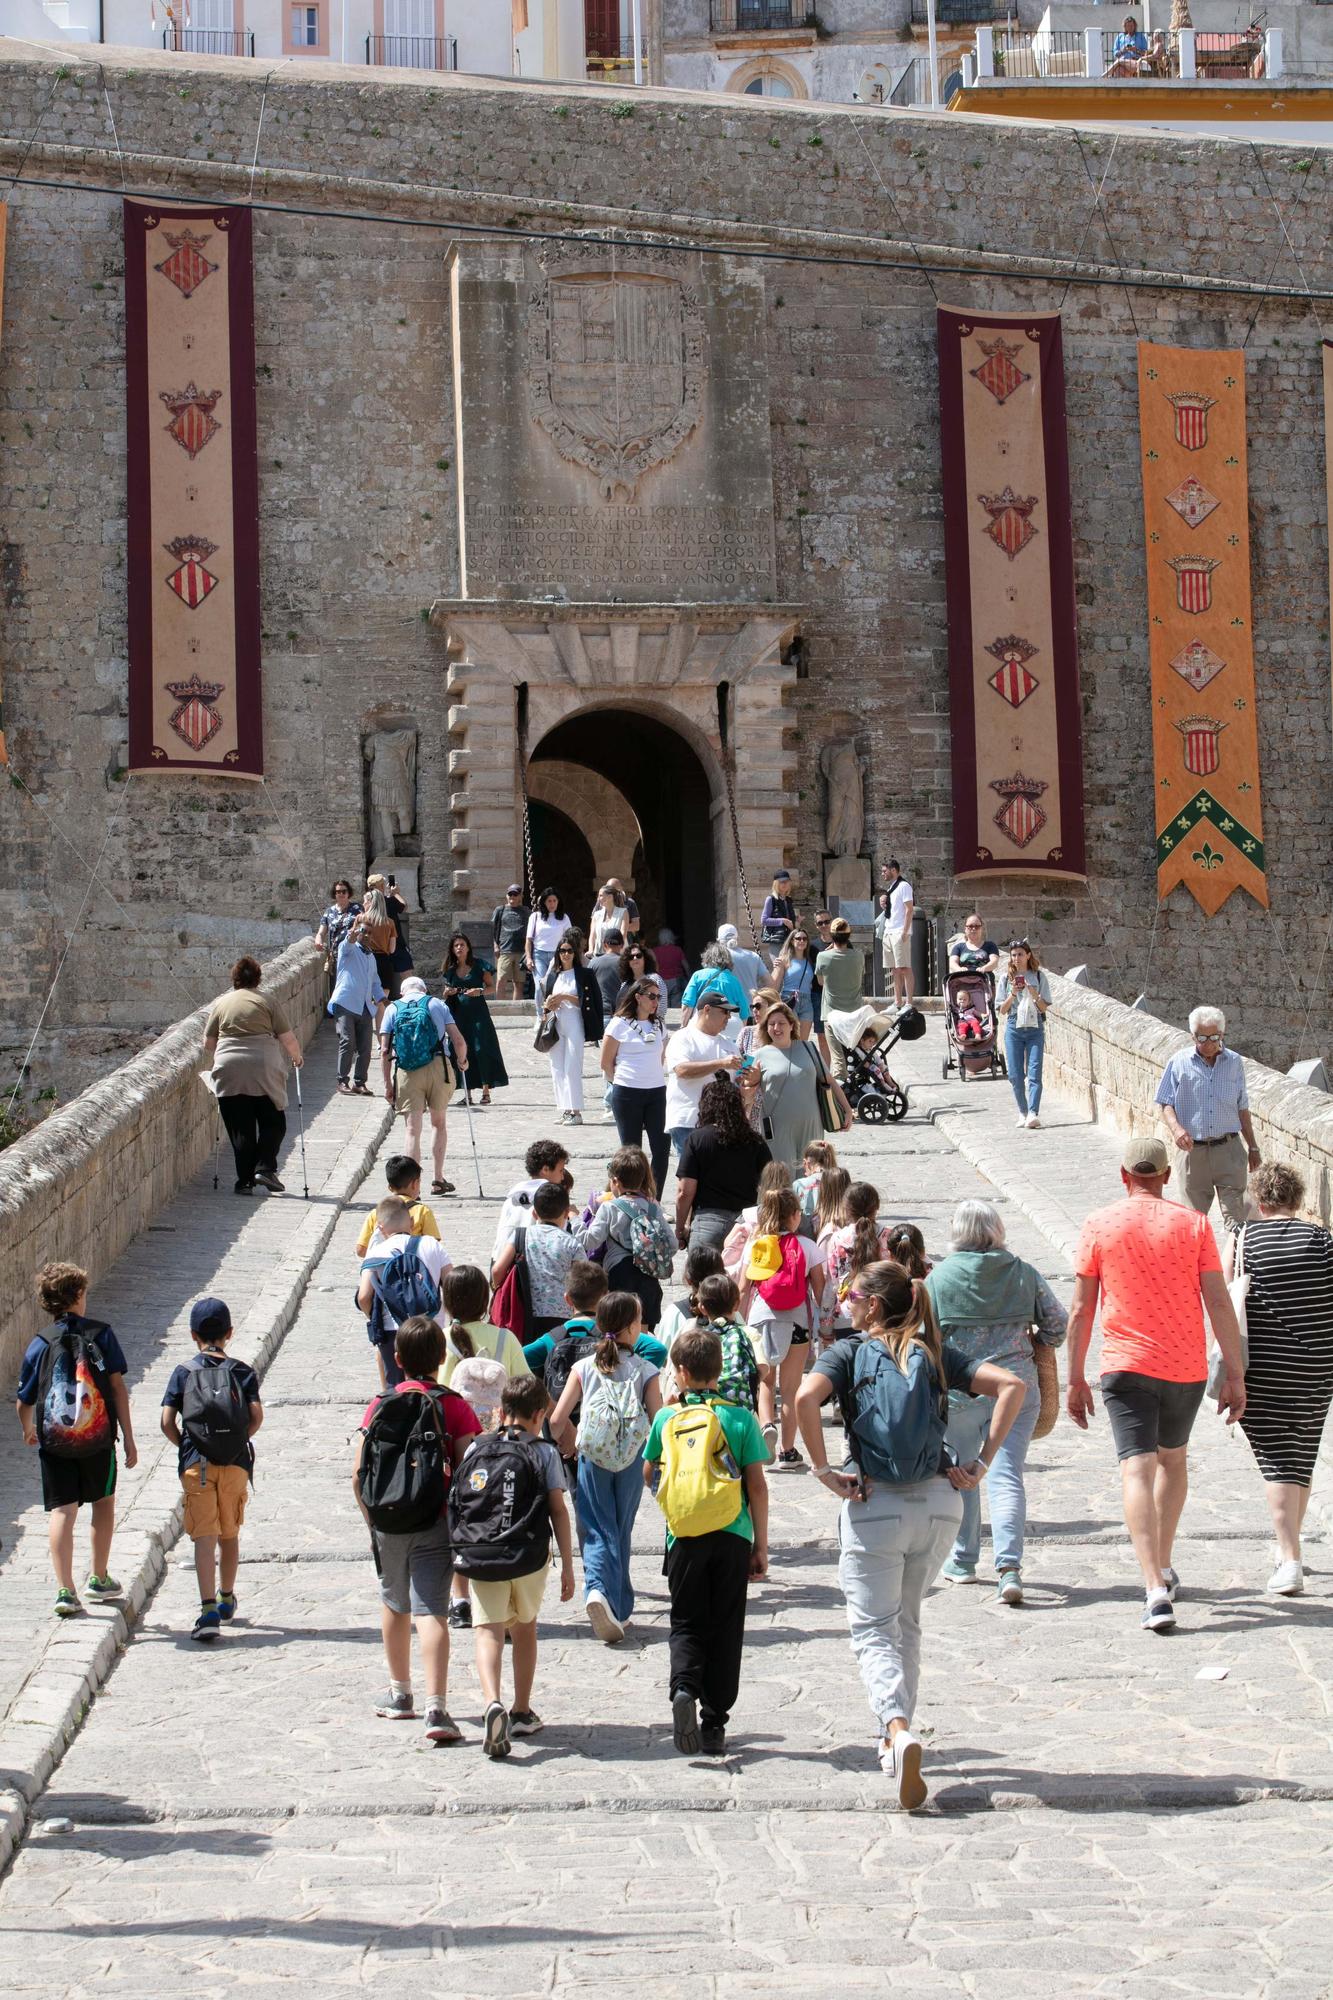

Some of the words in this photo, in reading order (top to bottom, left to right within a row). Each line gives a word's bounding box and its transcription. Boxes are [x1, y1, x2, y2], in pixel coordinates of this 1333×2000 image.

[536, 506, 578, 517] REGE
[583, 506, 678, 518] CATHOLICO
[684, 573, 735, 584] ANNO
